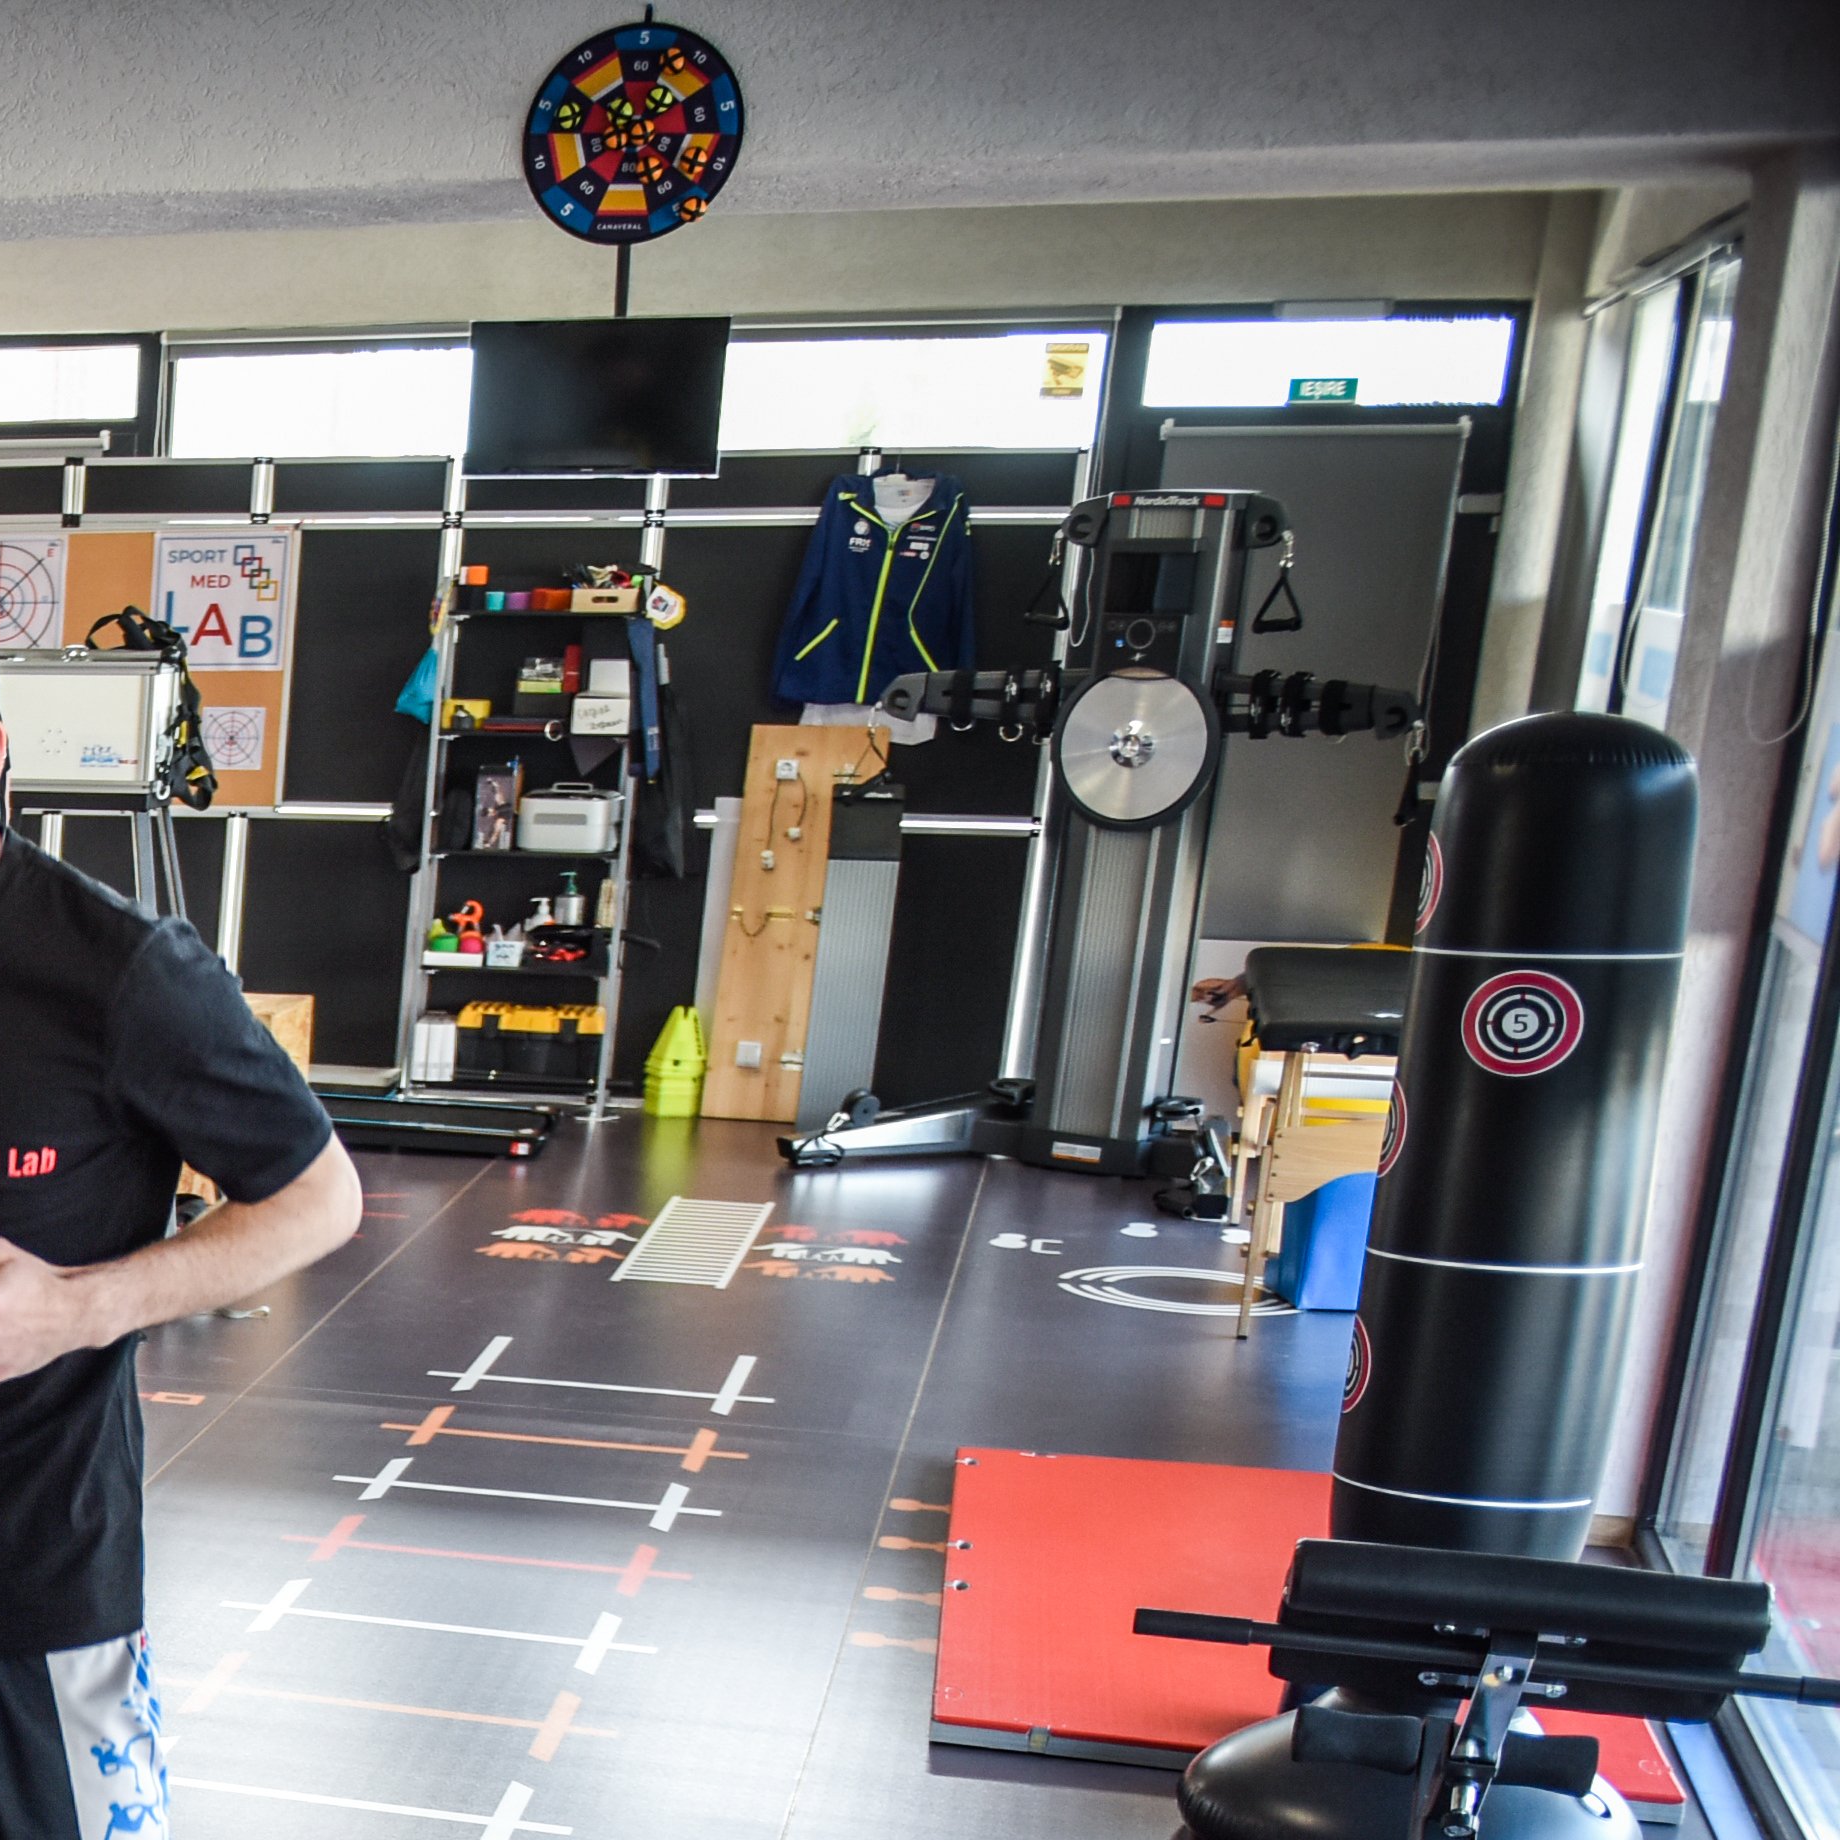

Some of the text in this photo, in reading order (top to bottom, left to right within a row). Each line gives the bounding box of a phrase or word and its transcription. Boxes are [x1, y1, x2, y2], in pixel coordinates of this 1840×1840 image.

[640, 31, 650, 45] 5
[578, 50, 593, 64] 10
[692, 50, 707, 64] 10
[634, 60, 649, 71] 60
[539, 99, 552, 110] 5
[721, 100, 735, 112] 5
[694, 106, 706, 122] 60
[534, 155, 545, 170] 10
[713, 156, 726, 171] 10
[579, 180, 594, 195] 60
[657, 180, 673, 195] 60
[560, 203, 575, 216] 5
[168, 549, 227, 564] SPORT
[191, 574, 231, 589] MED
[1512, 1013, 1529, 1033] 5
[8, 1146, 58, 1178] Lab
